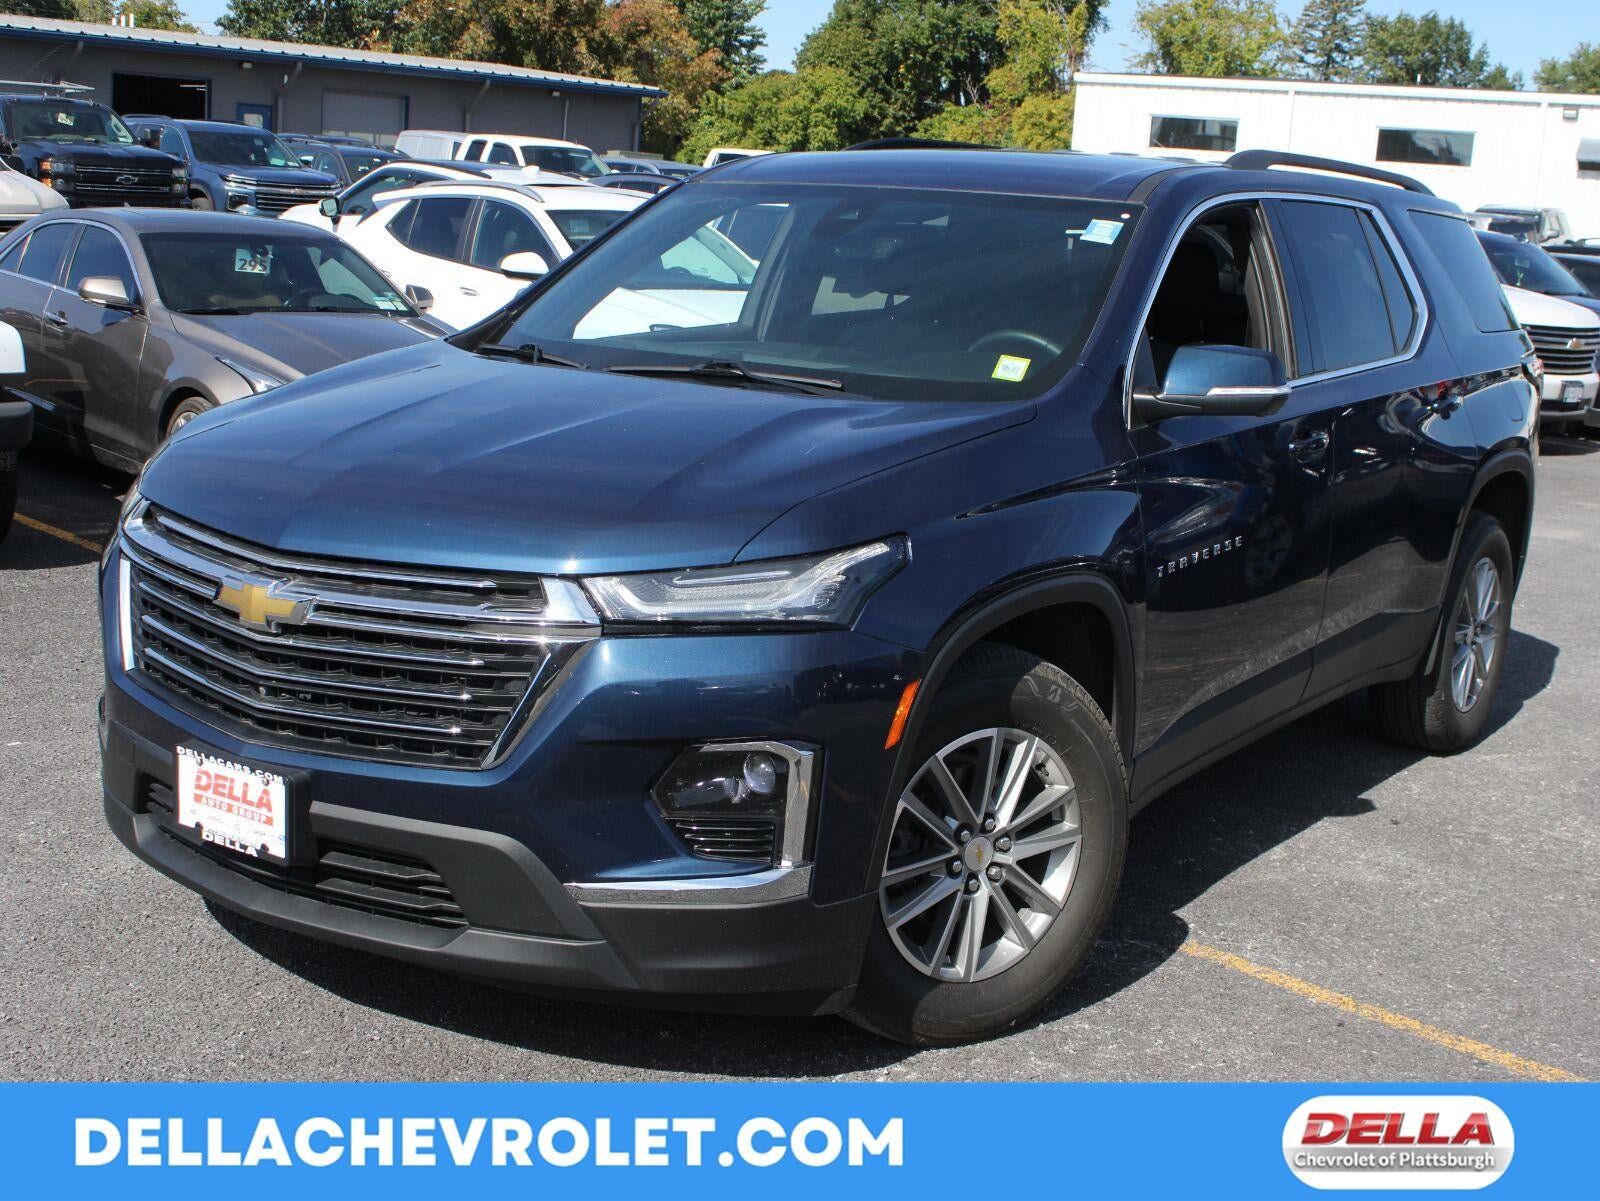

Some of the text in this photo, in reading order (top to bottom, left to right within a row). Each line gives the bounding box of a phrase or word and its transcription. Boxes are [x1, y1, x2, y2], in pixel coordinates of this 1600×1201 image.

[238, 258, 268, 272] 295
[1157, 535, 1242, 578] TRAVERSE
[176, 745, 284, 786] DELLACARS.COM
[194, 768, 273, 814] DELLA
[201, 796, 266, 824] AUTO GROUP
[202, 833, 259, 858] DELLA
